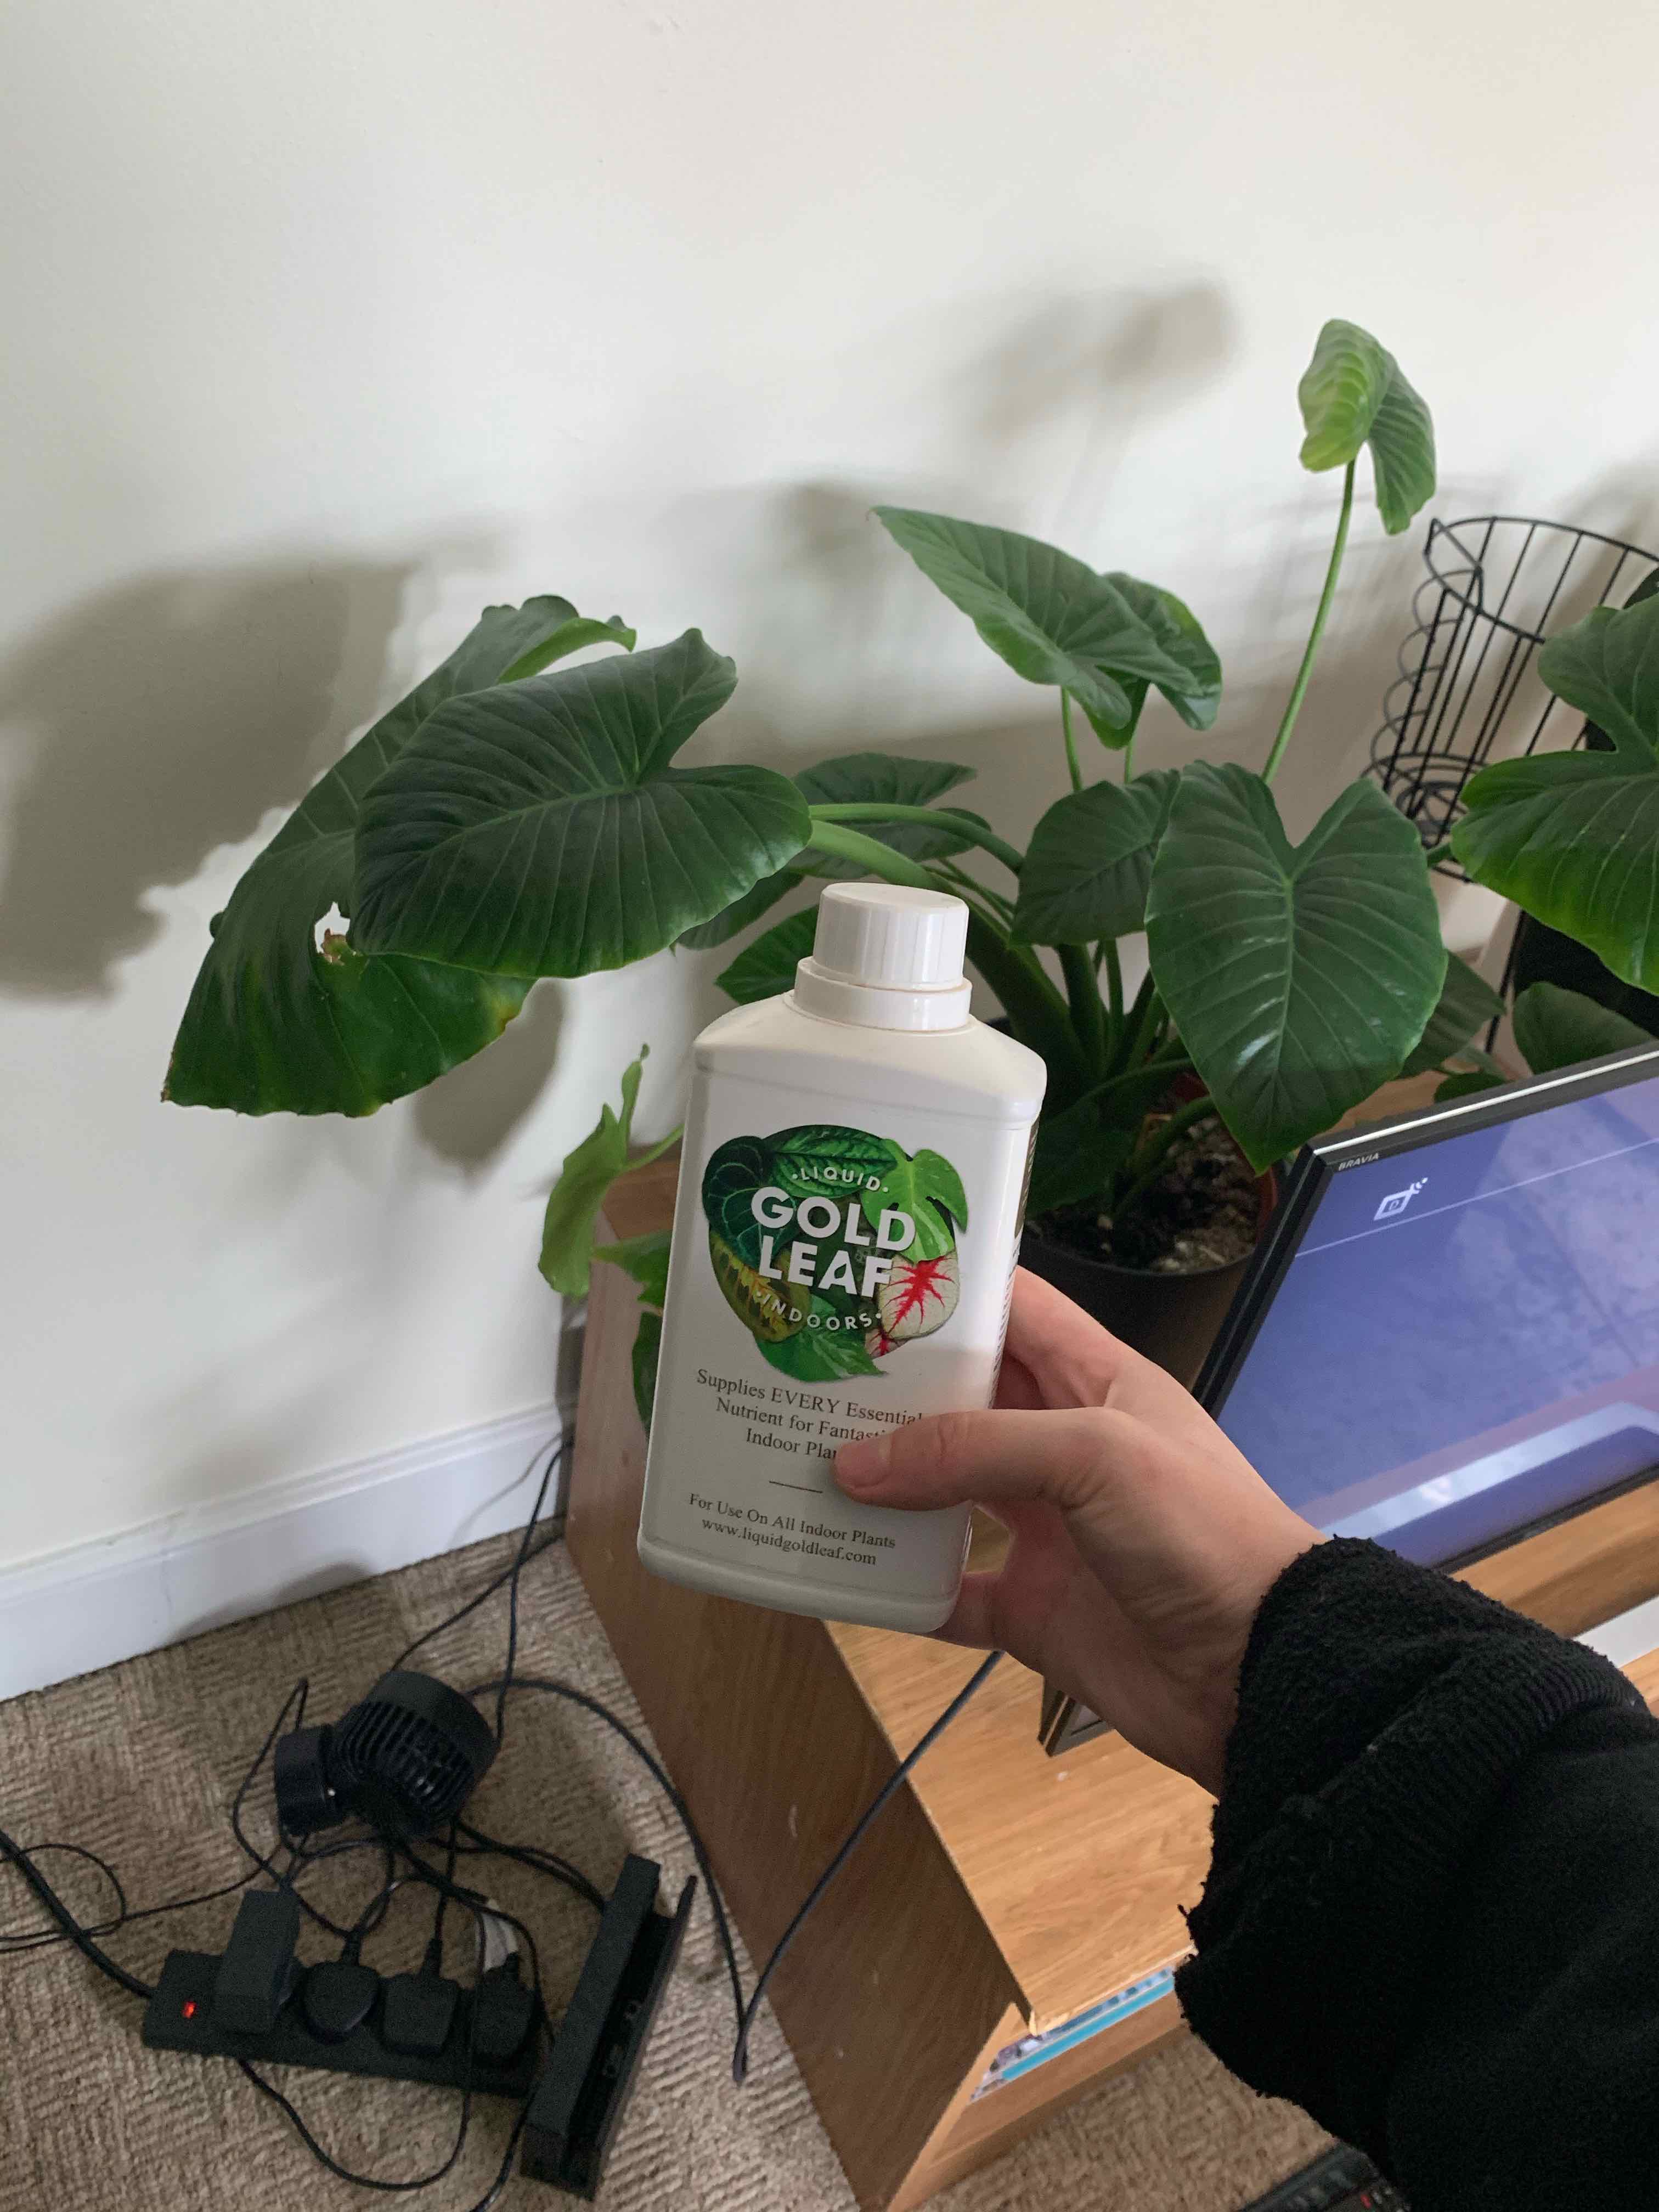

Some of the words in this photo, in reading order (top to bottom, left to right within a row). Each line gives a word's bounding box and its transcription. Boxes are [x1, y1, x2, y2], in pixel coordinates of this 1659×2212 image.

[800, 1166, 881, 1192] LIQUID
[1338, 1153, 1379, 1171] BRAVIA
[751, 1187, 917, 1251] GOLD
[758, 1235, 893, 1298] LEAF
[762, 1293, 872, 1331] INDOORS
[697, 1369, 765, 1400] Supplies
[771, 1387, 840, 1414] EVERY
[716, 1397, 783, 1426] Nutrient
[789, 1414, 814, 1432] for
[746, 1428, 800, 1453] Indoor
[689, 1493, 713, 1510] For
[717, 1500, 743, 1519] Use
[747, 1509, 768, 1525] On
[772, 1516, 795, 1531] All
[800, 1520, 848, 1541] Indoor
[851, 1530, 896, 1549] Plants
[702, 1519, 876, 1565] www.liquidgoldleaf.com
